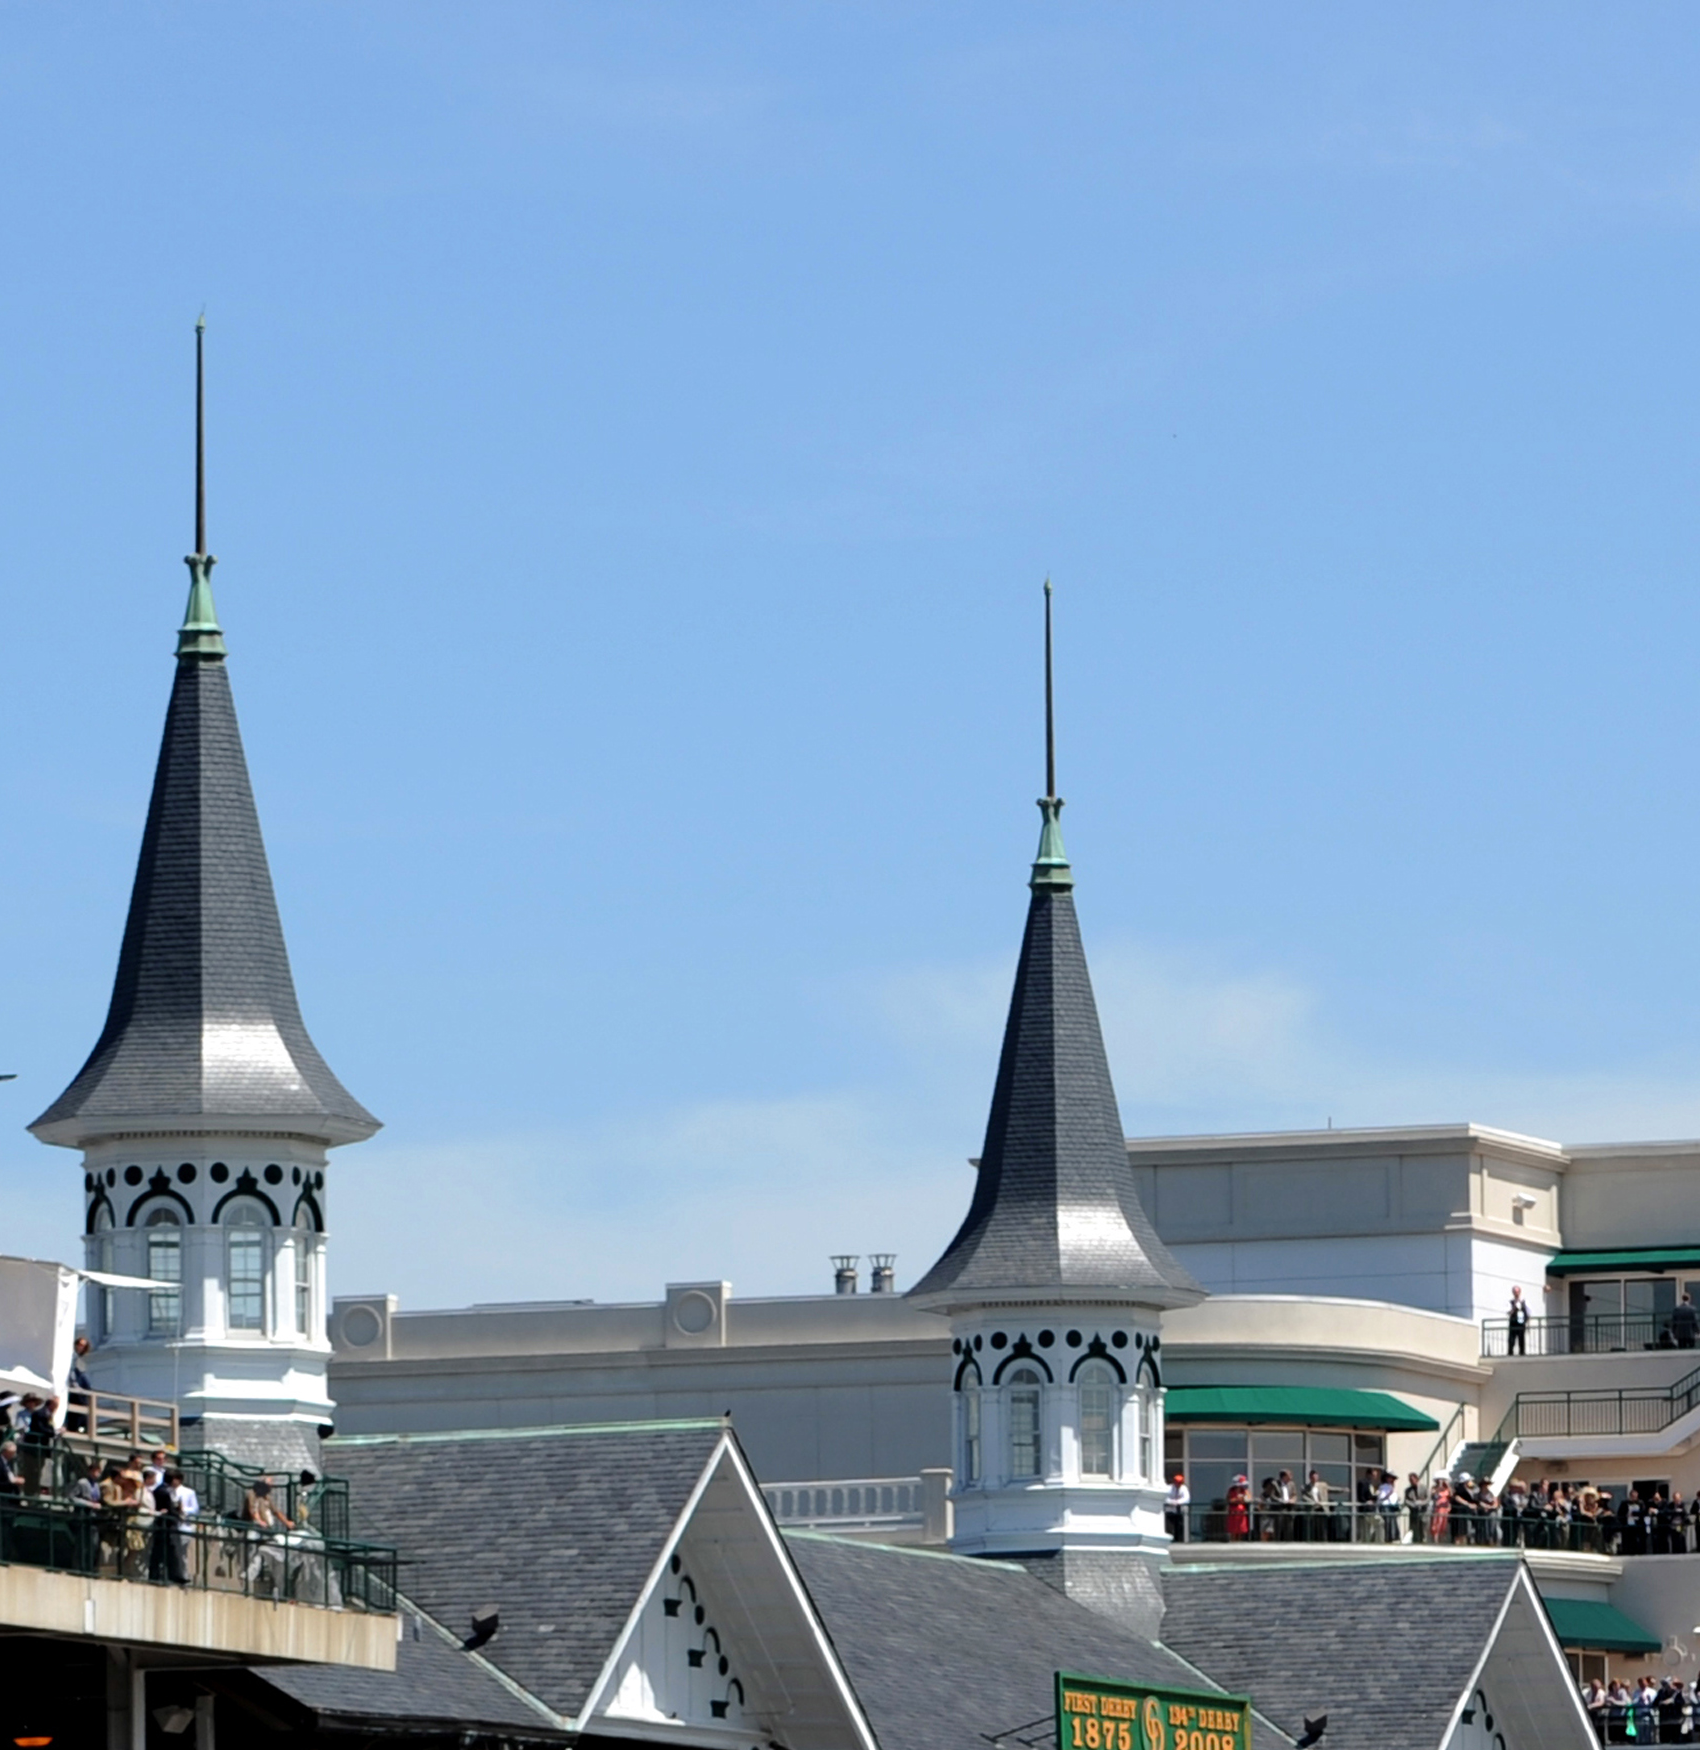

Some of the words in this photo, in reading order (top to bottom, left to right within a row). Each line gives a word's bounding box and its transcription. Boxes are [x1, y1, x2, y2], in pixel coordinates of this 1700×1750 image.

[1063, 1691, 1098, 1714] FIRST
[1101, 1696, 1137, 1720] DERBY
[1199, 1709, 1241, 1732] DERBY
